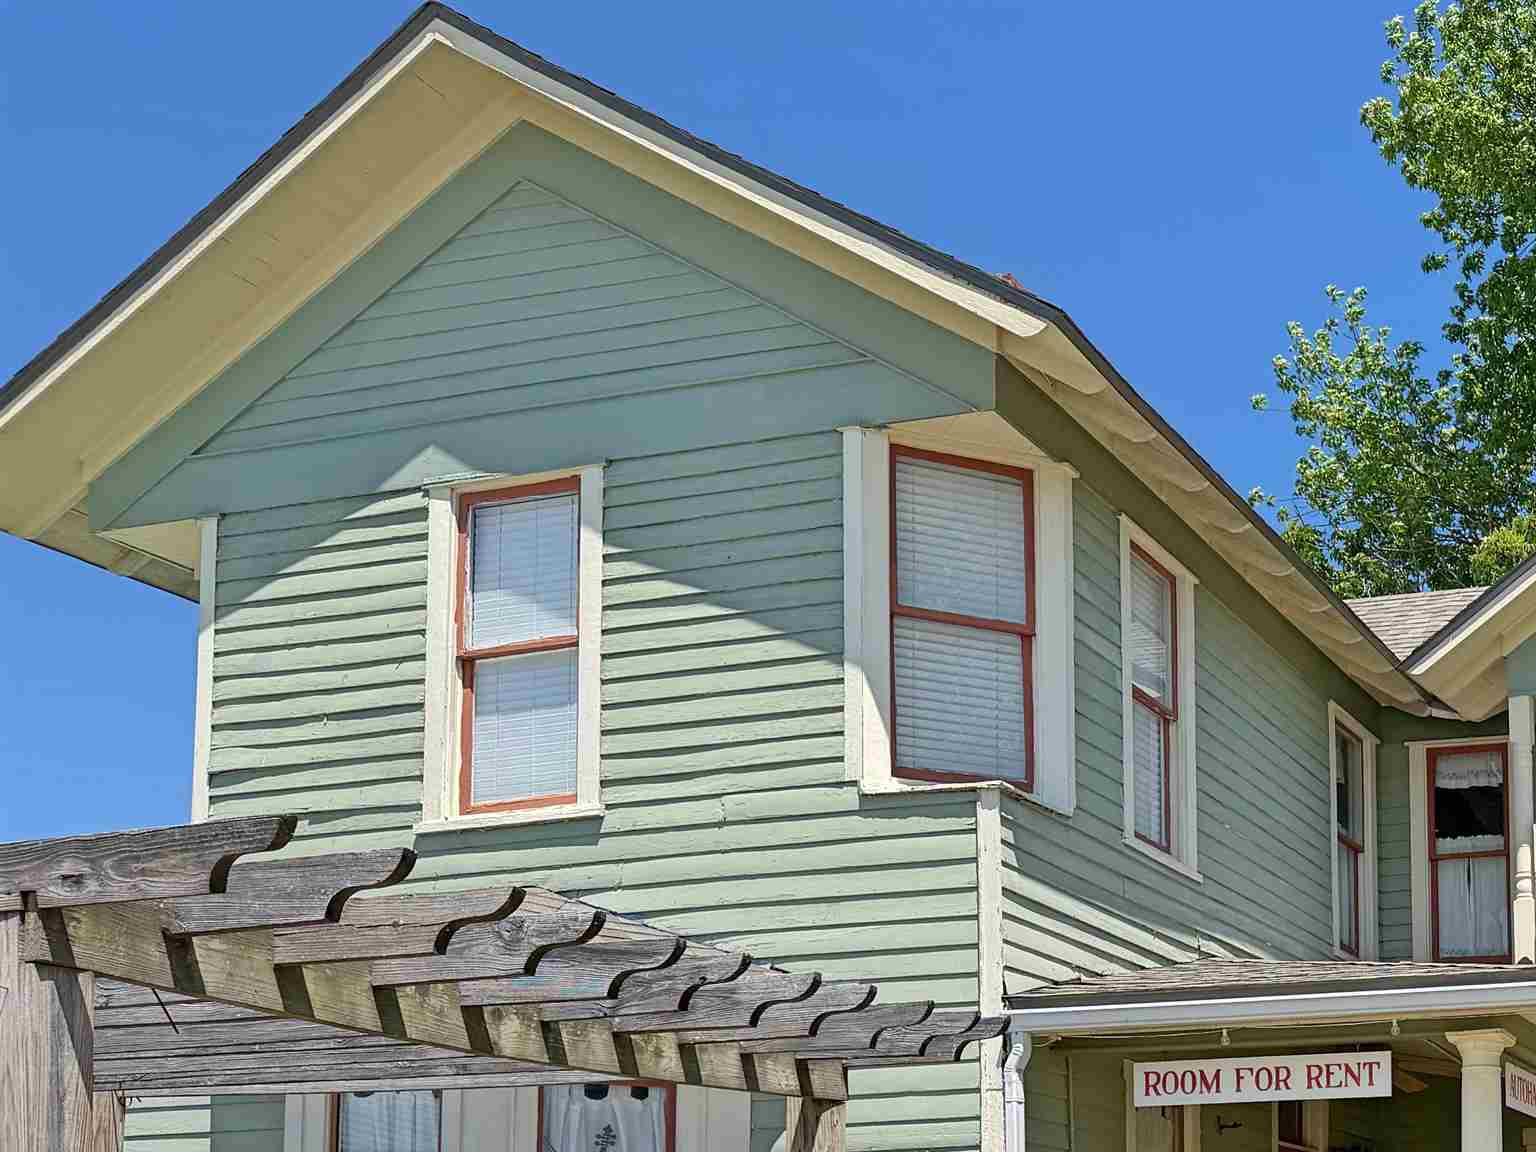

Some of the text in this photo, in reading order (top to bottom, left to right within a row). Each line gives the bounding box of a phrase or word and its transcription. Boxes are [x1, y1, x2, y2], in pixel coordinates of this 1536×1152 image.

[1143, 1061, 1381, 1097] ROOM FOR RENT
